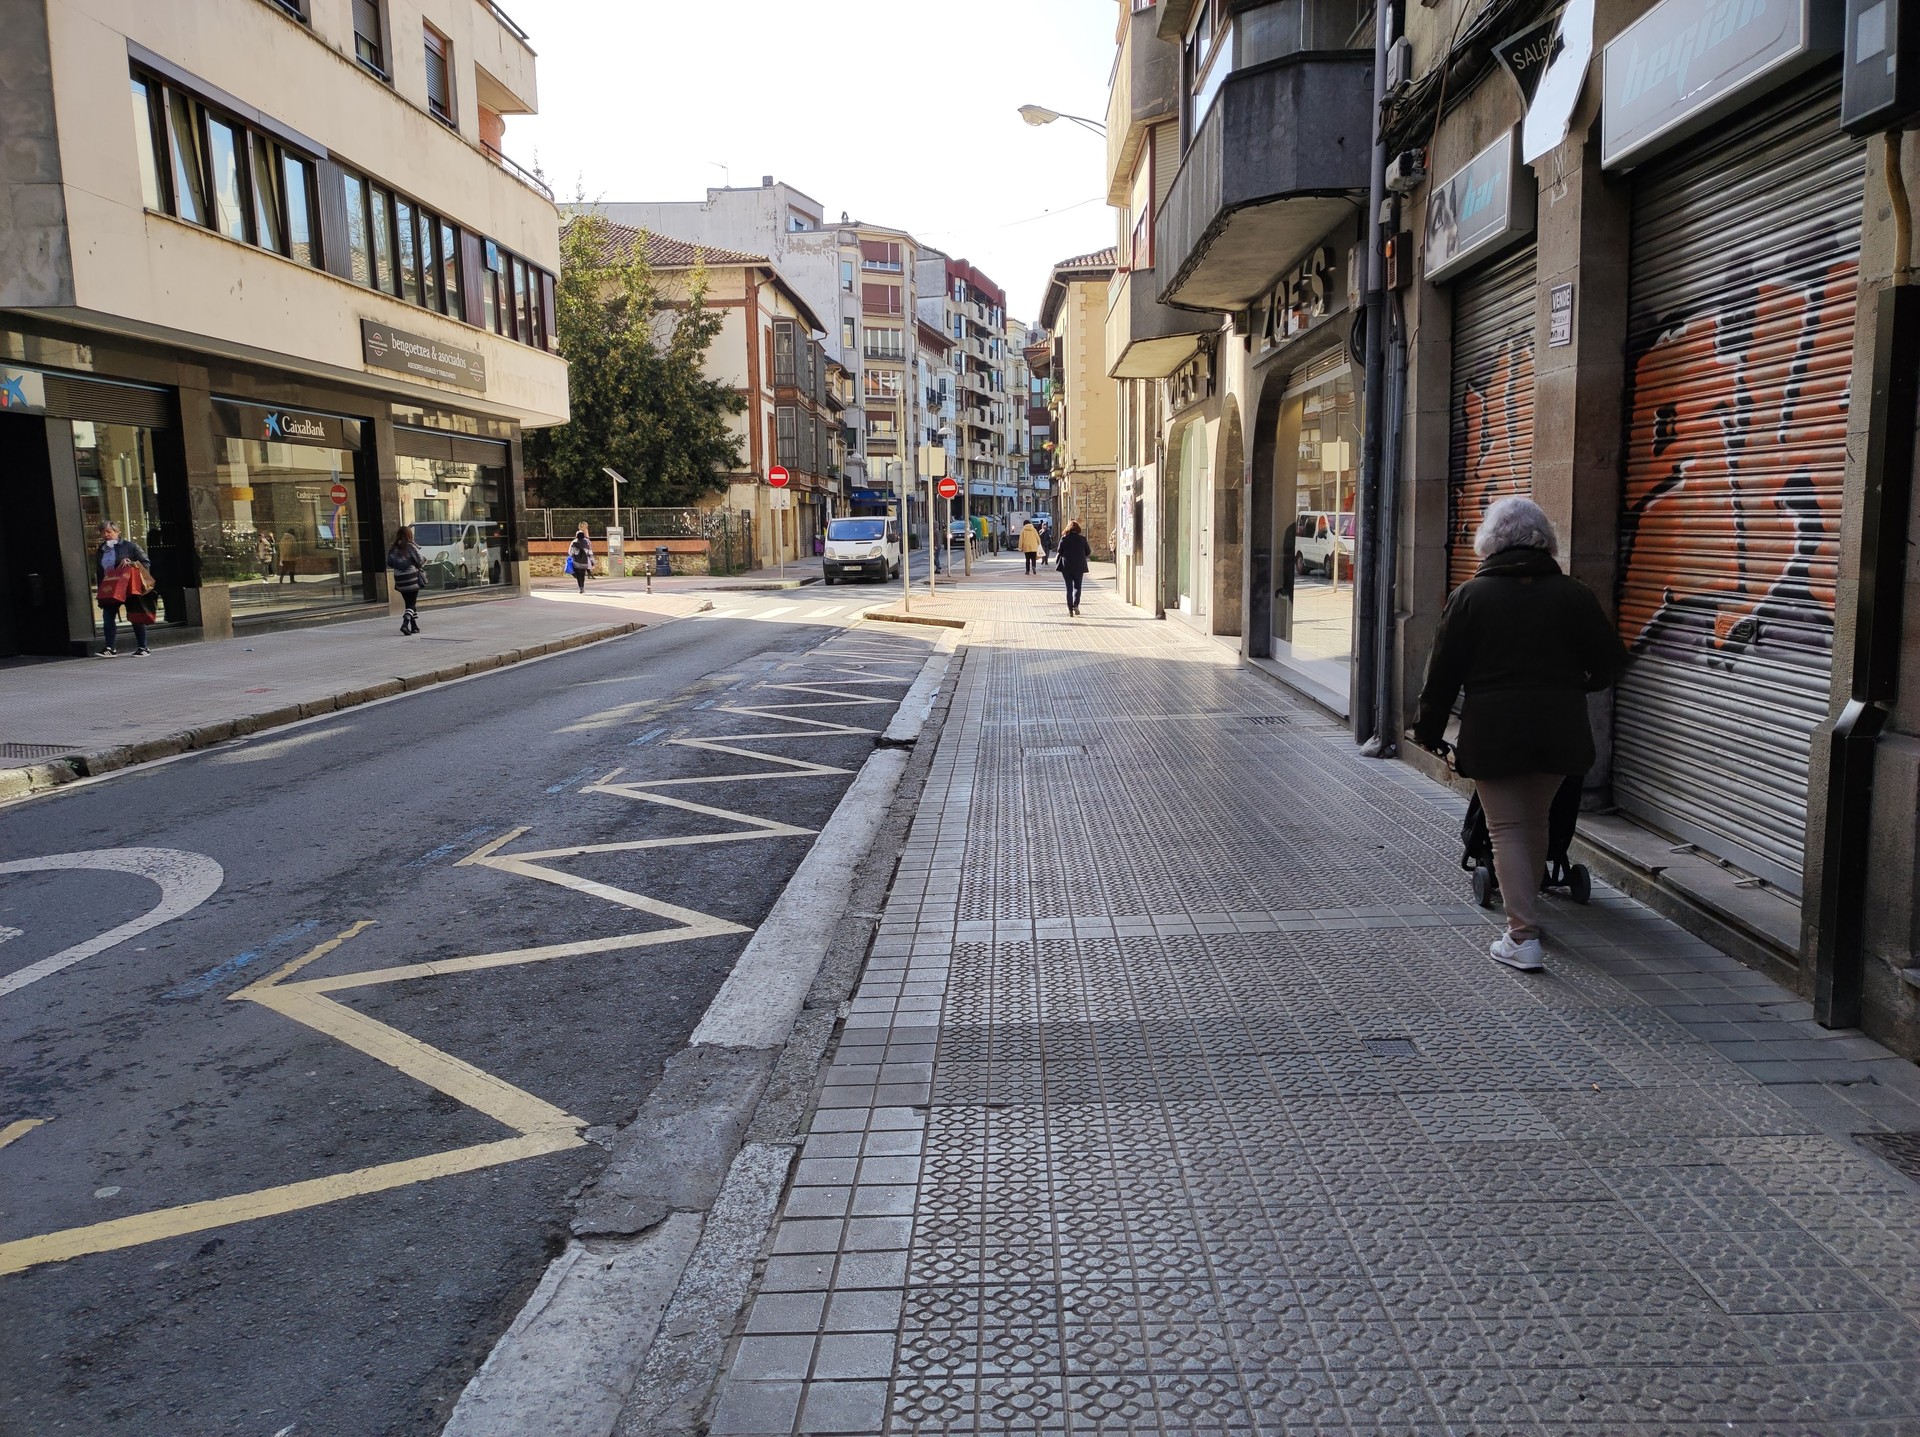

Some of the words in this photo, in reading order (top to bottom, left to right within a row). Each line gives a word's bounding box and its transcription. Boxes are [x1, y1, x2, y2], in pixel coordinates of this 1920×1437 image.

[391, 333, 430, 358] bengoetxea
[431, 345, 438, 361] &
[438, 351, 467, 369] asociados
[281, 415, 326, 437] CaixaBank
